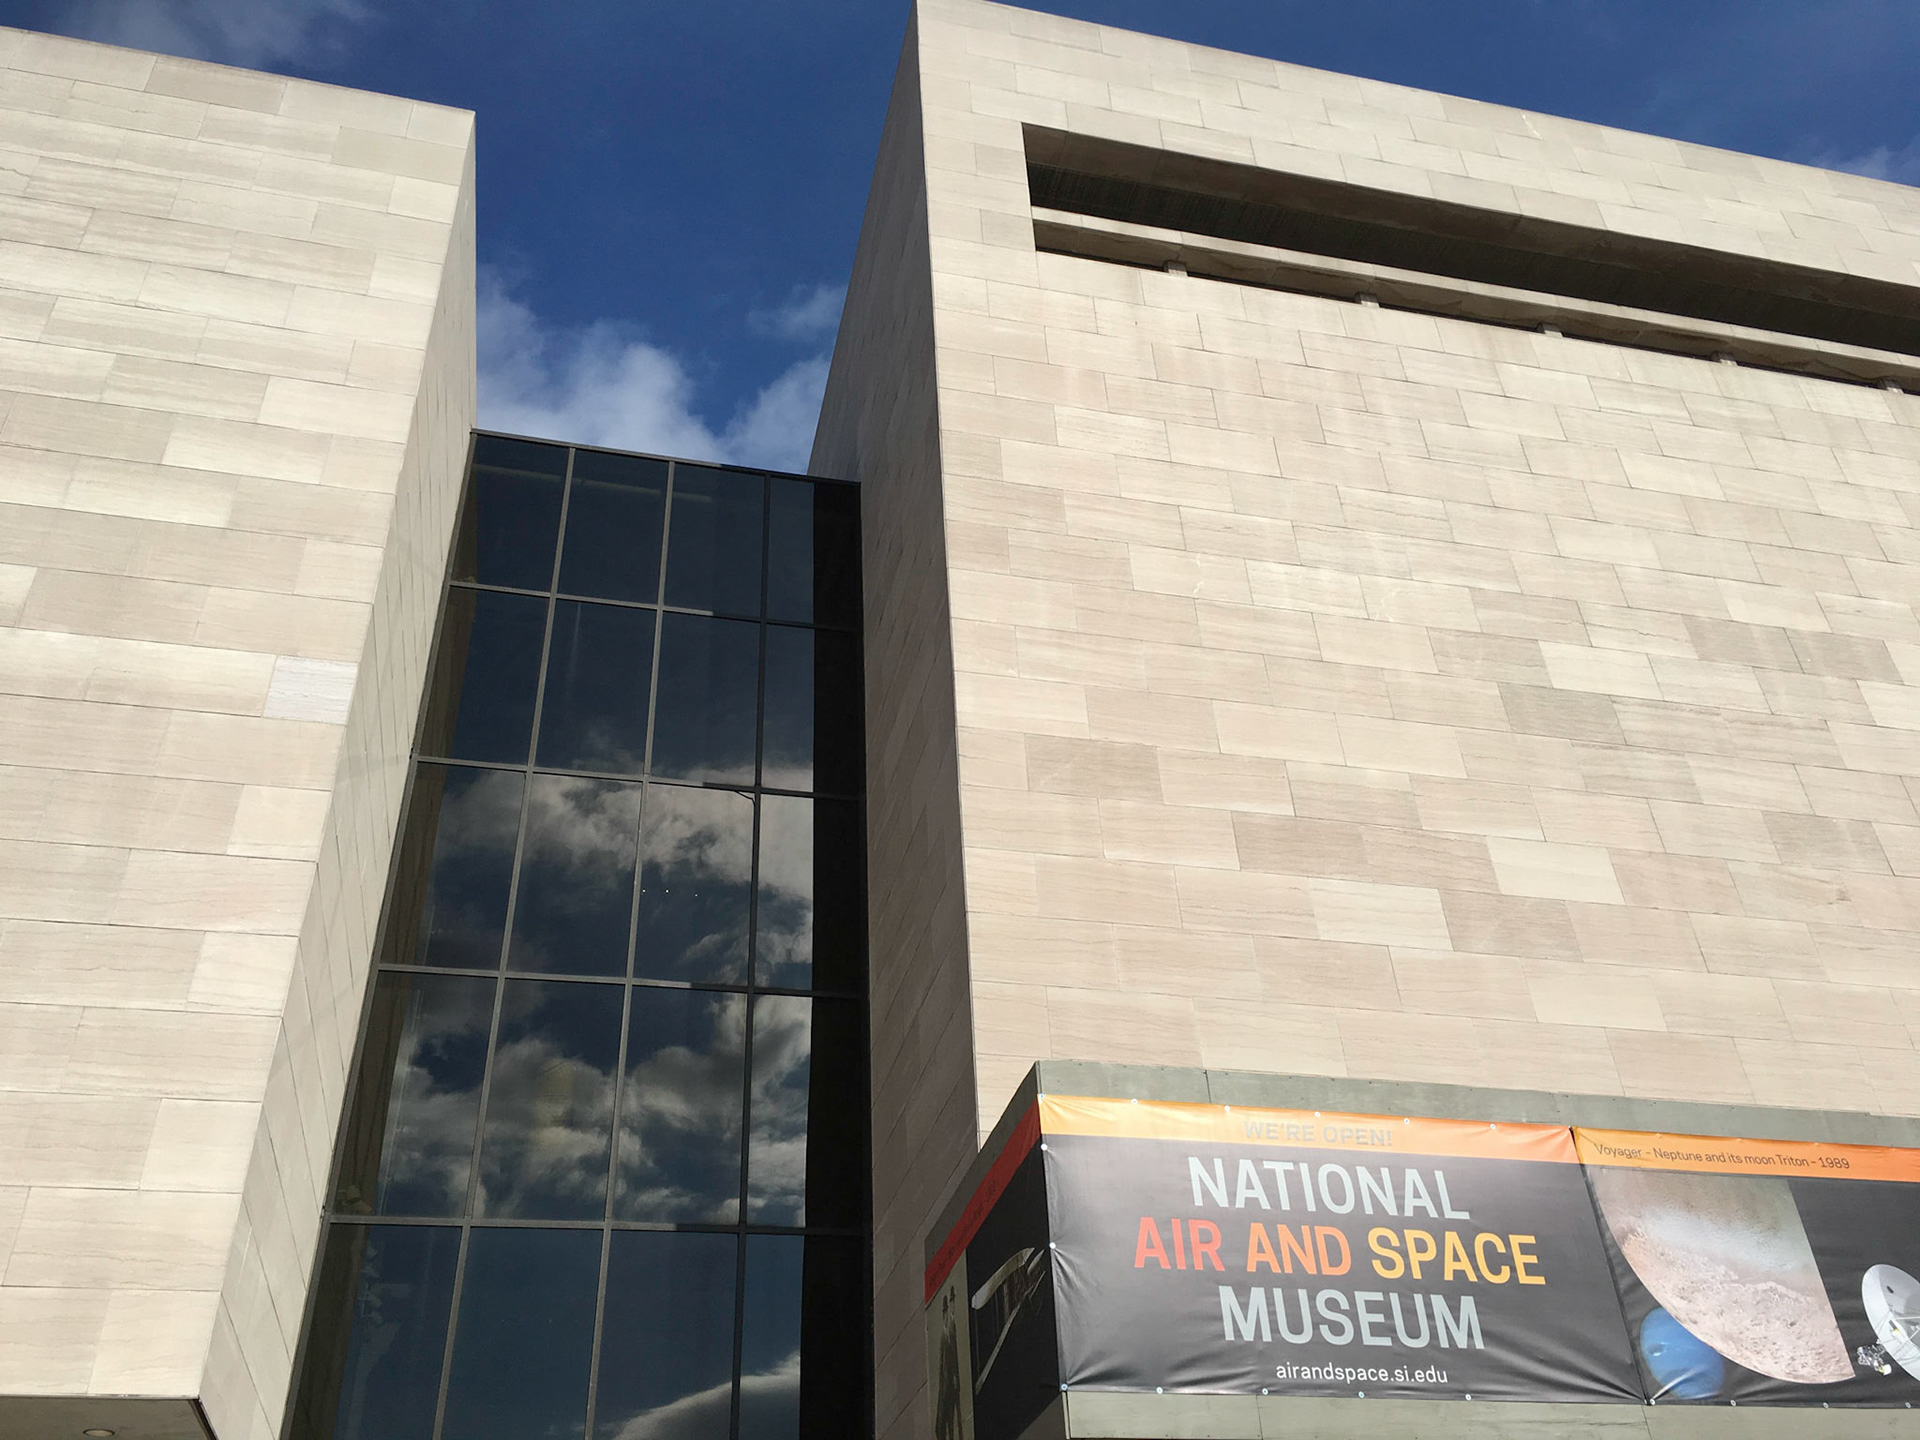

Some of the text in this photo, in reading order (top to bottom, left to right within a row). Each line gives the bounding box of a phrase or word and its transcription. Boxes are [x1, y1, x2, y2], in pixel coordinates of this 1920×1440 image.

[1244, 1121, 1392, 1146] WE'RE OPEN!
[1594, 1144, 1642, 1160] Voyager
[1653, 1147, 1703, 1165] Neptune
[1705, 1151, 1726, 1164] and
[1727, 1153, 1743, 1165] its
[1744, 1156, 1776, 1167] moon
[1776, 1154, 1810, 1168] Triton
[1818, 1156, 1851, 1170] 1989
[1188, 1156, 1471, 1220] NATIONAL
[1134, 1217, 1546, 1285] AIR AND SPACE
[1218, 1285, 1485, 1350] MUSEUM
[1276, 1362, 1448, 1384] airandspace.si.edu
